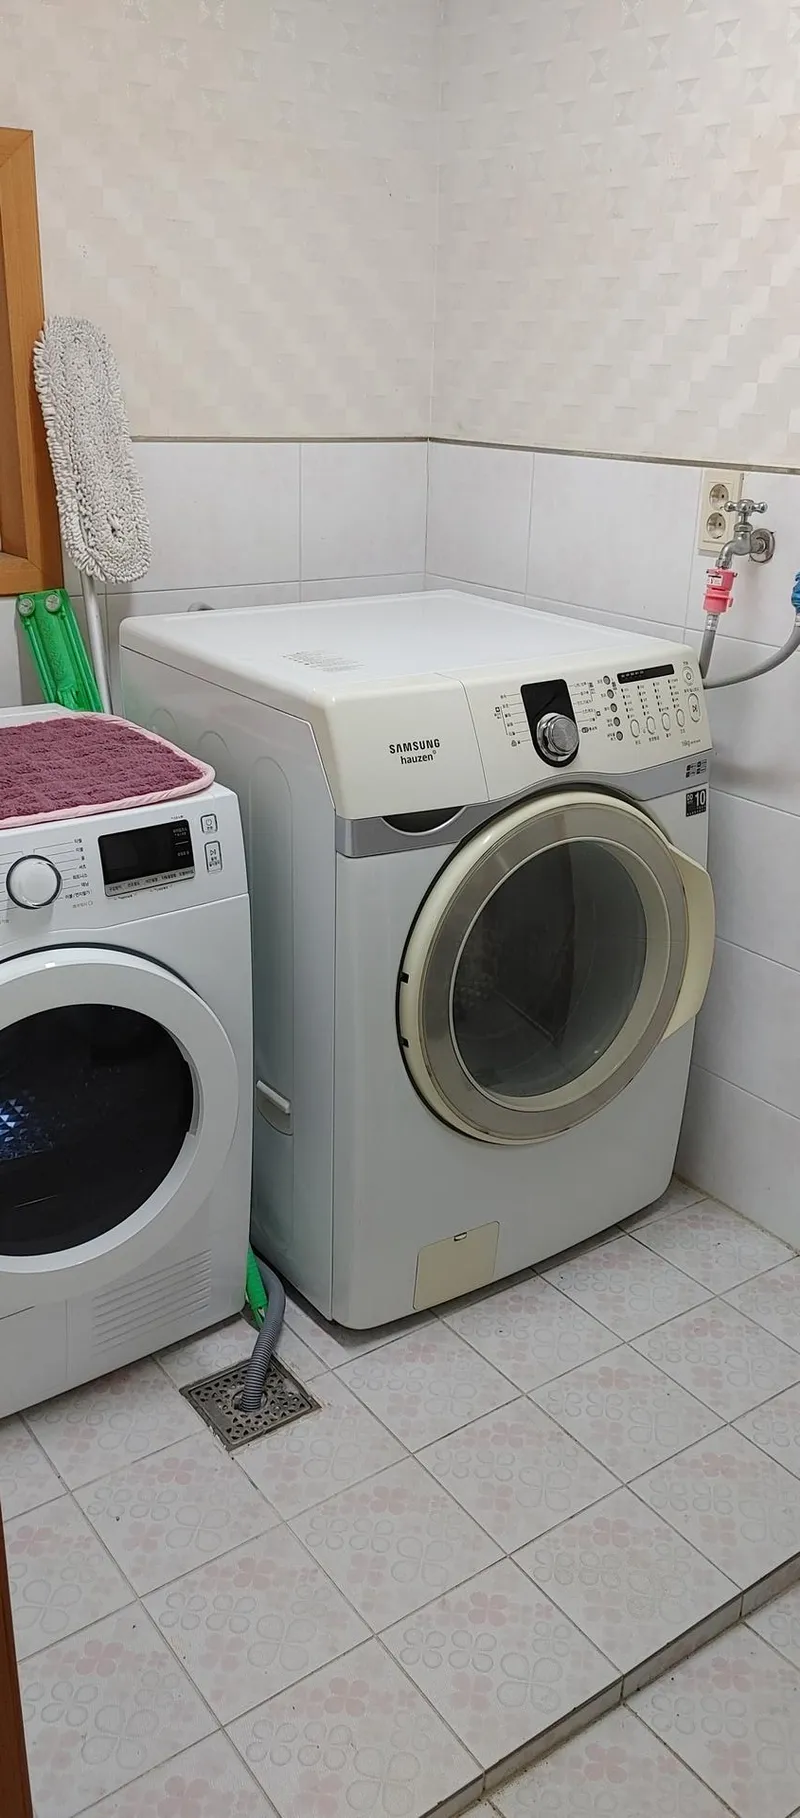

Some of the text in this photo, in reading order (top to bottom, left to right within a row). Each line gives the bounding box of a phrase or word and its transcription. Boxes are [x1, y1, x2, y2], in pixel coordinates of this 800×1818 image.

[389, 738, 441, 754] SAMSUNG
[400, 753, 434, 765] hauzen
[694, 790, 706, 807] 10
